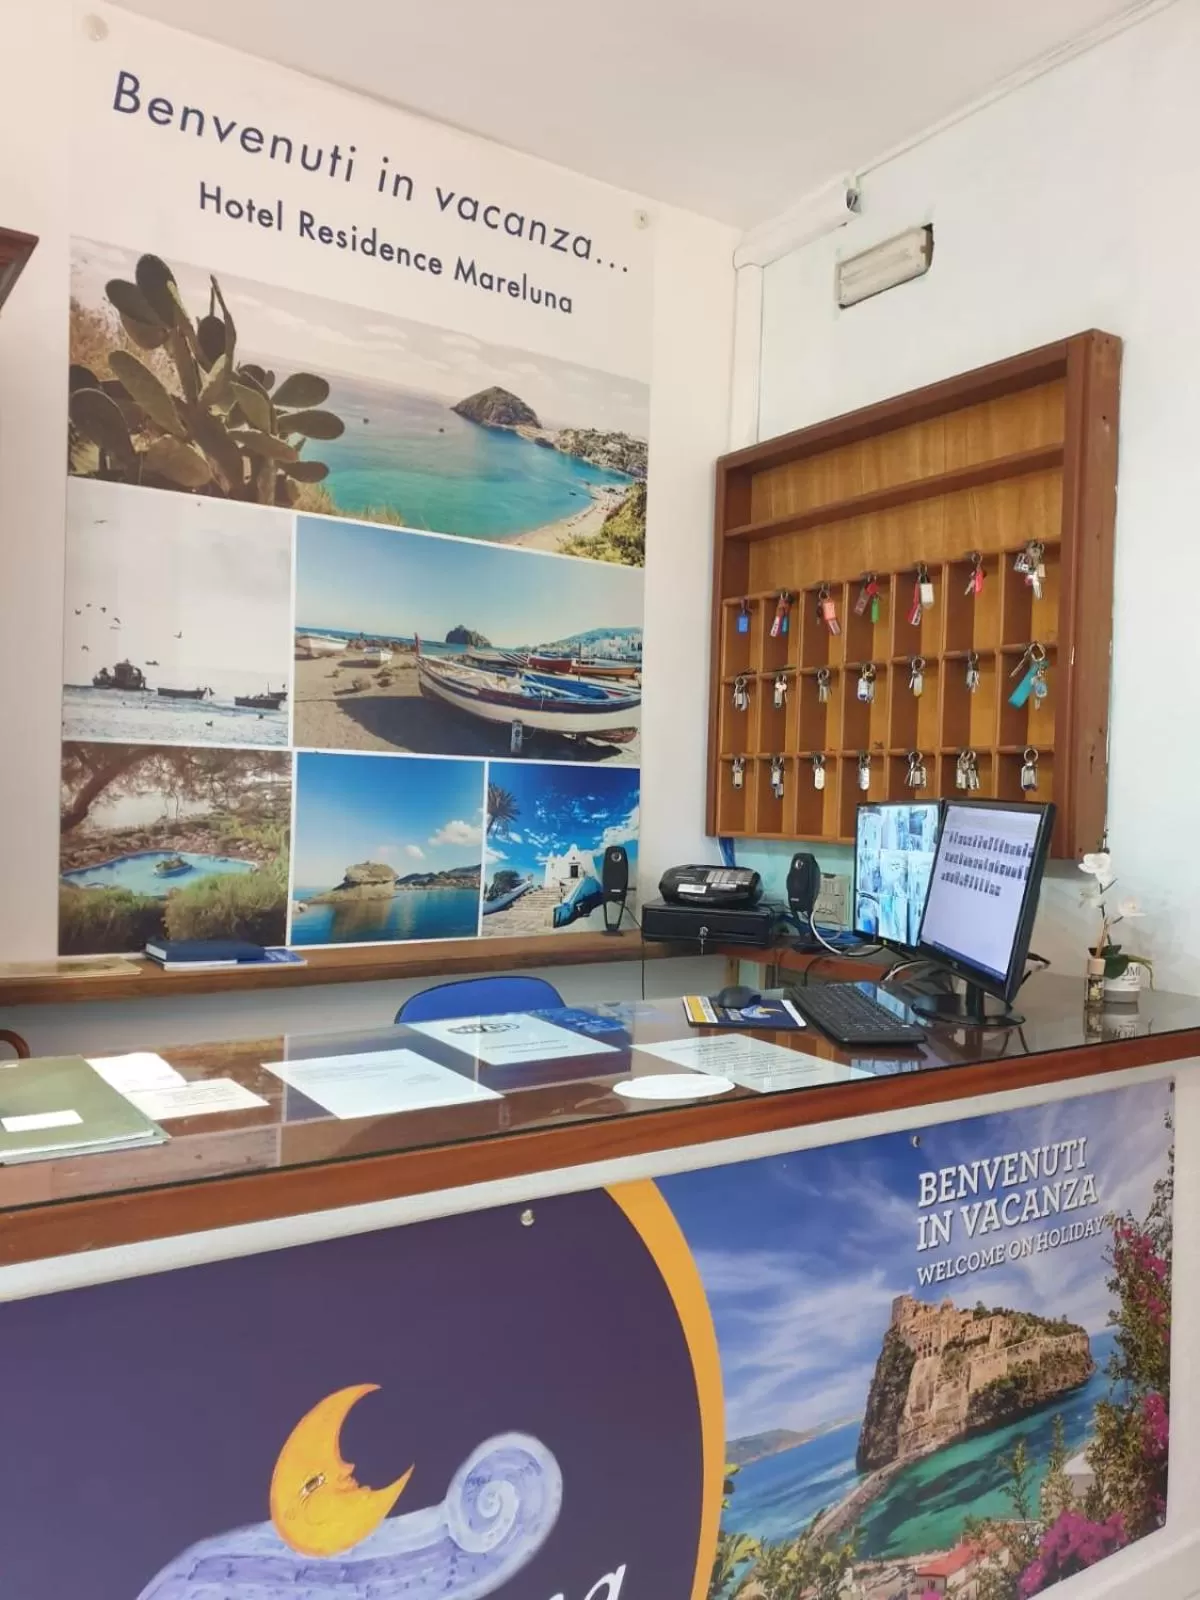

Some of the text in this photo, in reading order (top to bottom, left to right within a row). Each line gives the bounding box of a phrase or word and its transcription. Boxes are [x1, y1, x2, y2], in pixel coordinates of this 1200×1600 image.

[111, 70, 358, 184] Benvenuti
[377, 156, 415, 202] in
[199, 181, 574, 316] Hotel Residence Mareluna
[917, 1136, 1089, 1209] BENVENUTI
[915, 1173, 1100, 1252] IN VACANZA
[916, 1215, 1105, 1287] WELCOME ON HOLIDAY
